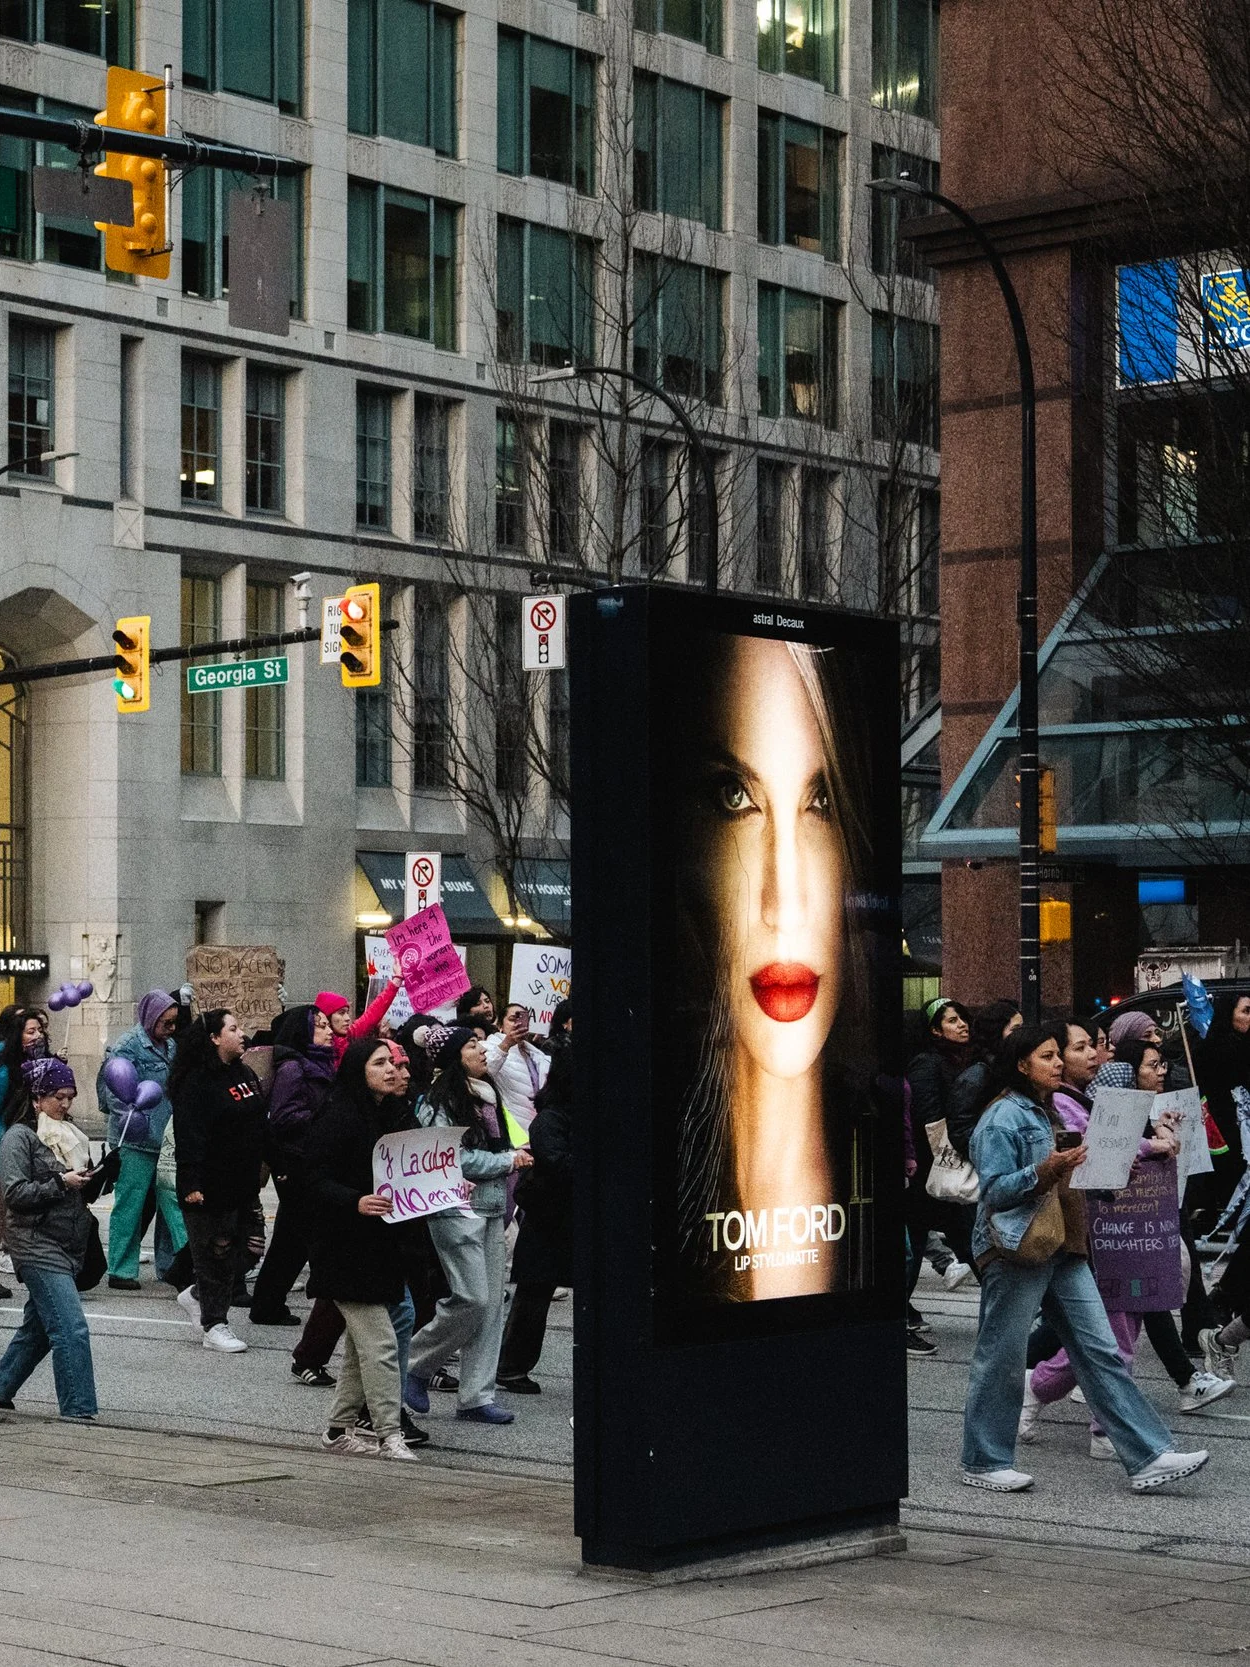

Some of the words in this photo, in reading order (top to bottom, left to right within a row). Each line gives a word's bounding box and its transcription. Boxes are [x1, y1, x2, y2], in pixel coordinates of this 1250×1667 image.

[327, 605, 342, 617] RIG
[329, 623, 342, 636] TU
[753, 613, 773, 626] astral
[776, 614, 805, 629] Decaux
[195, 664, 256, 685] Georgia
[263, 661, 282, 678] St
[1038, 866, 1061, 879] Hornb
[380, 878, 398, 890] MY
[443, 881, 475, 893] BUNS
[405, 921, 428, 938] here
[428, 908, 440, 925] 4
[426, 931, 443, 947] the
[425, 943, 451, 962] women
[195, 955, 223, 974] NO
[227, 957, 273, 975] HACER
[434, 959, 449, 974] who
[200, 981, 235, 996] NADA
[241, 980, 255, 993] TE
[528, 979, 546, 996] LA
[421, 1139, 459, 1180] culpa
[394, 1186, 430, 1217] NO
[428, 1189, 453, 1206] era
[705, 1209, 768, 1252] TOM
[772, 1203, 846, 1247] FORD
[1093, 1217, 1135, 1235] CHANGE
[1144, 1221, 1155, 1235] IS
[1094, 1236, 1164, 1253] DAUGHTERS
[734, 1255, 751, 1272] LIP
[751, 1252, 785, 1269] STYLO
[785, 1248, 819, 1266] MATTE
